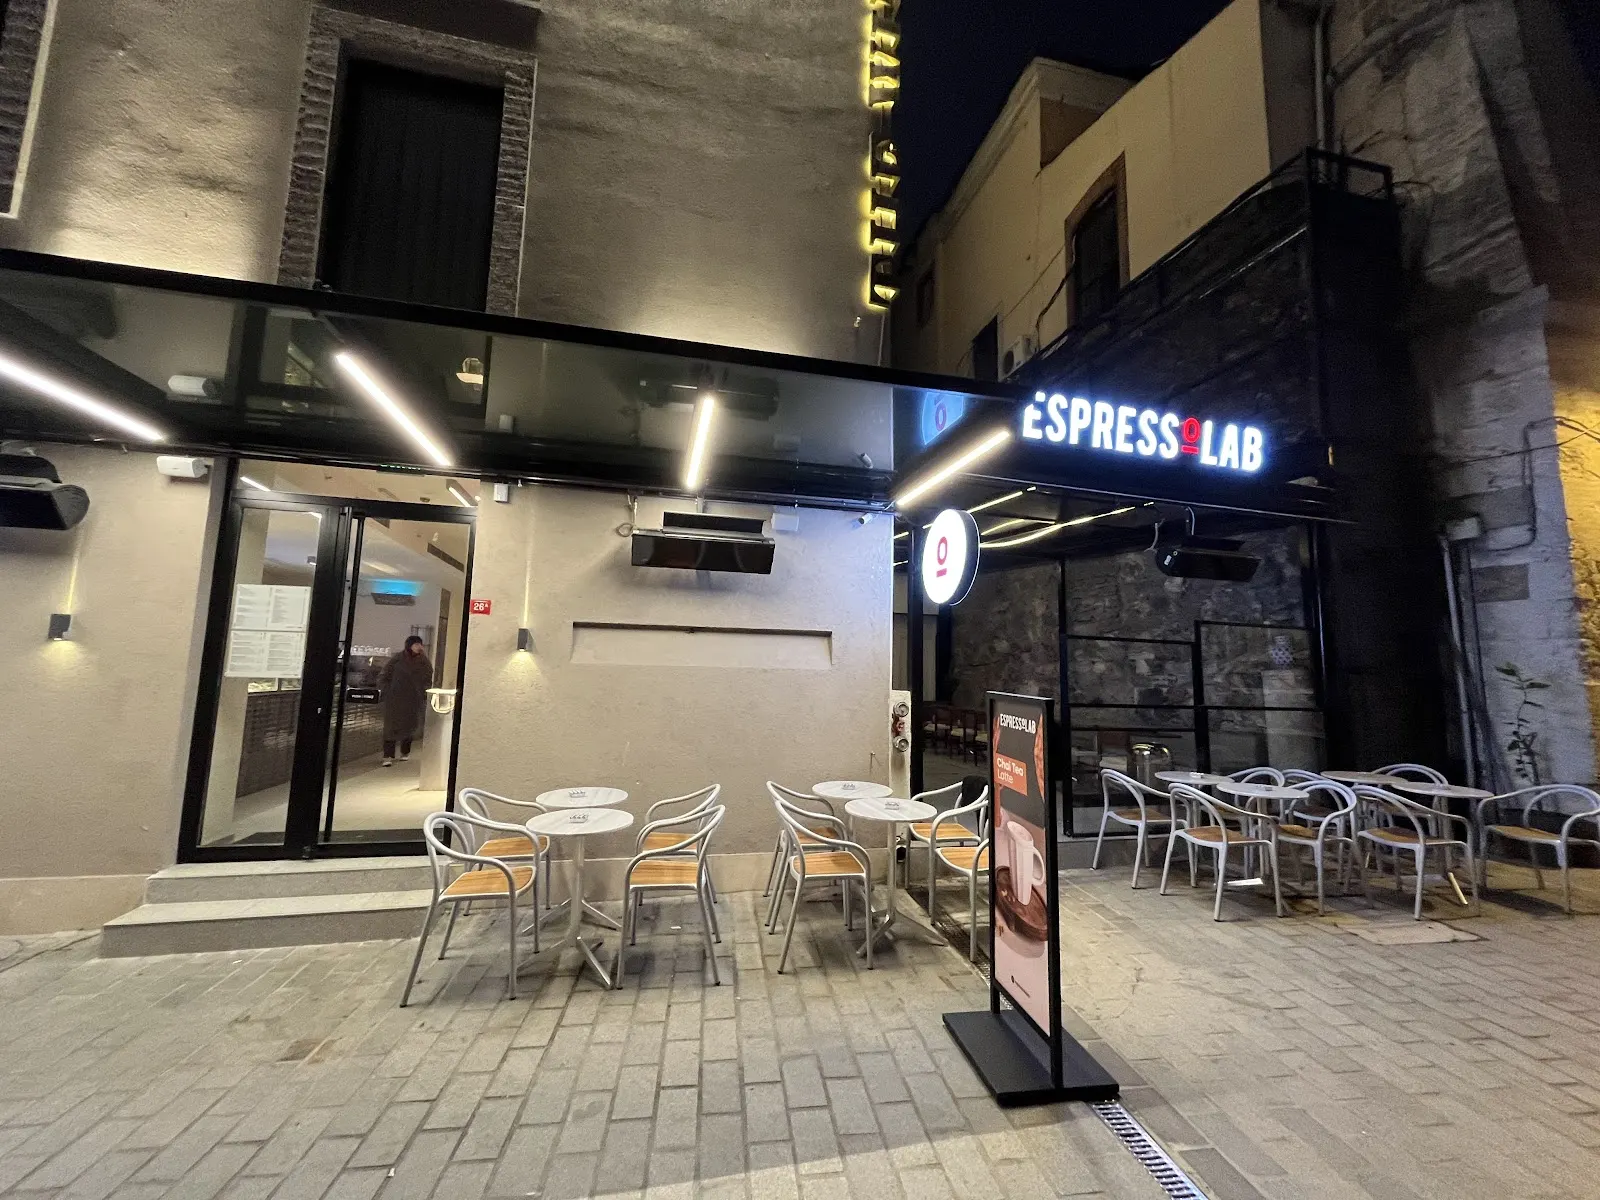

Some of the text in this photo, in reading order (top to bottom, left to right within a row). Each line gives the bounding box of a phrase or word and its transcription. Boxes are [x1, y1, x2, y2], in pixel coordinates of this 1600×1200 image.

[1022, 391, 1263, 472] ESPRESSOLAB
[1000, 713, 1036, 734] ESPRESSOLAB
[997, 758, 1024, 777] Chai Tea
[997, 769, 1014, 784] Latte
